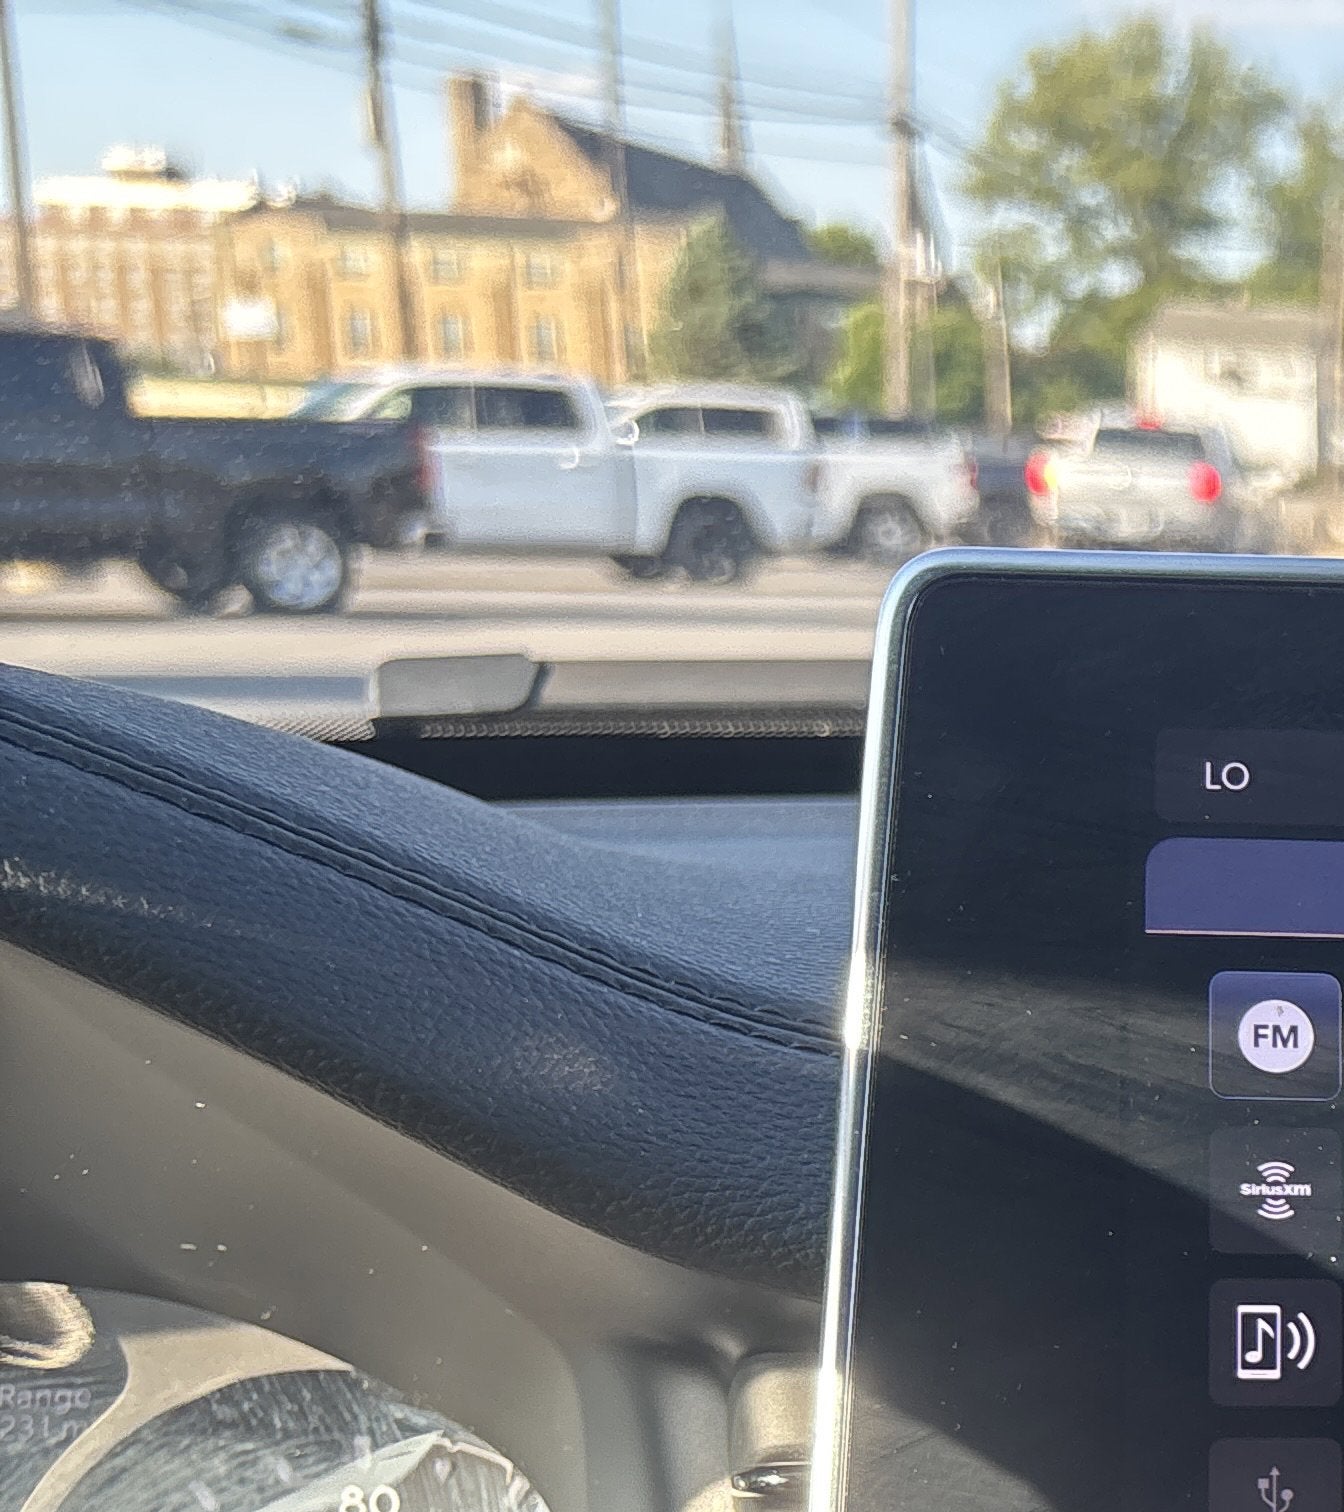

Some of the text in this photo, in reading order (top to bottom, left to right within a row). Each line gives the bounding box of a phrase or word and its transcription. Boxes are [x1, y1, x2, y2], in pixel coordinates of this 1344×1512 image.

[1205, 761, 1250, 790] LO
[1252, 1024, 1300, 1050] FM
[0, 1383, 91, 1415] Range
